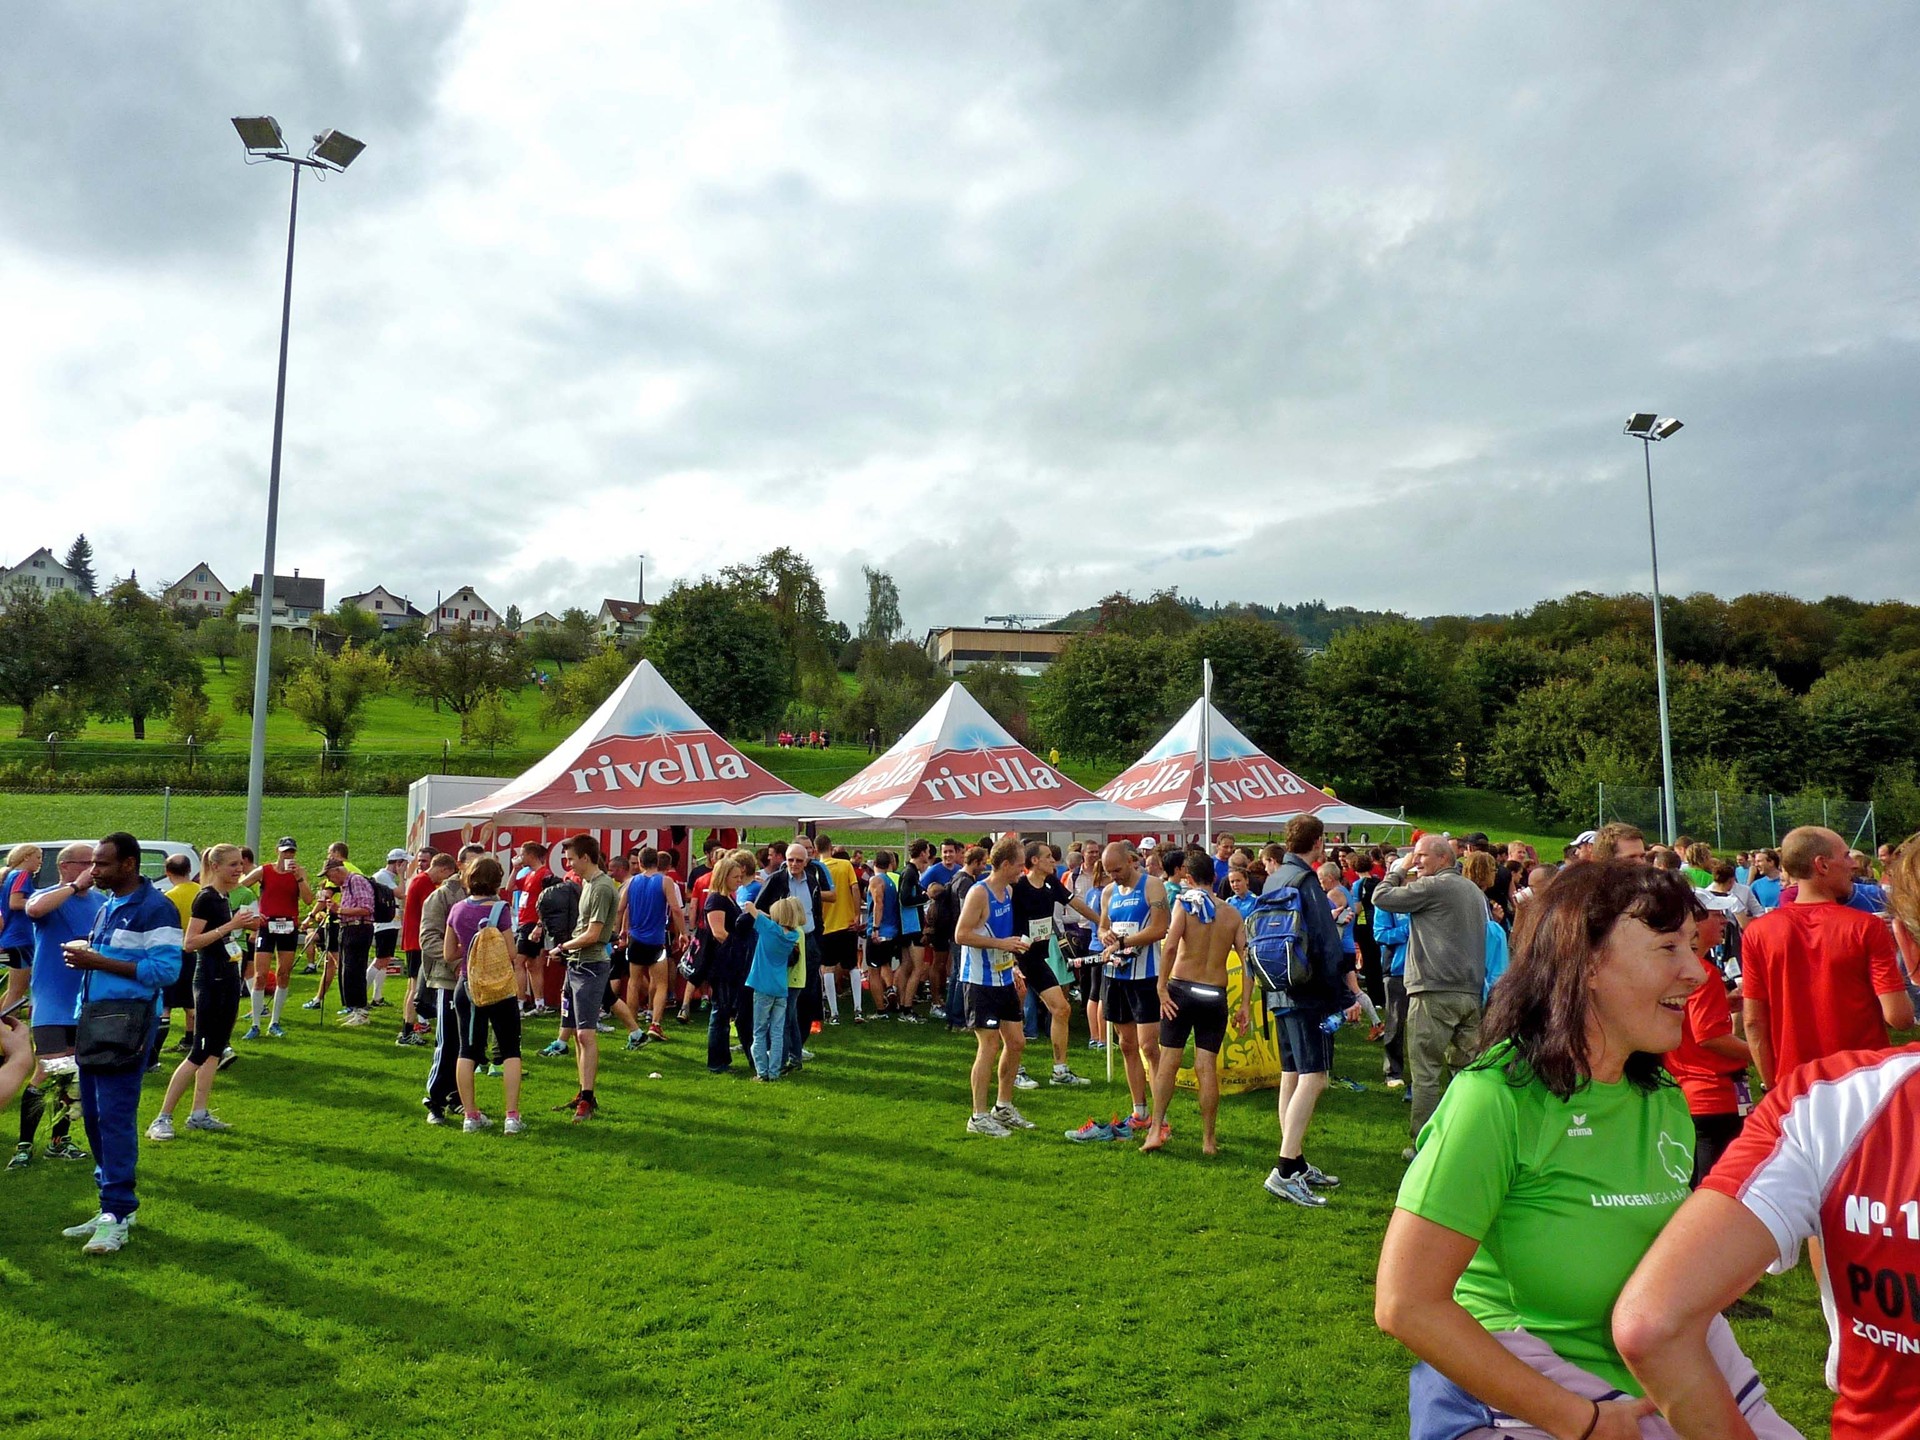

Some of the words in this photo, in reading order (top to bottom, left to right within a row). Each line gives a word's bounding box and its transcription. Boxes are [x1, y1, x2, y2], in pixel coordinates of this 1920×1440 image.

[569, 743, 750, 794] rivella
[826, 751, 927, 803] rivella
[922, 757, 1061, 801] rivella
[1567, 1127, 1593, 1137] erima
